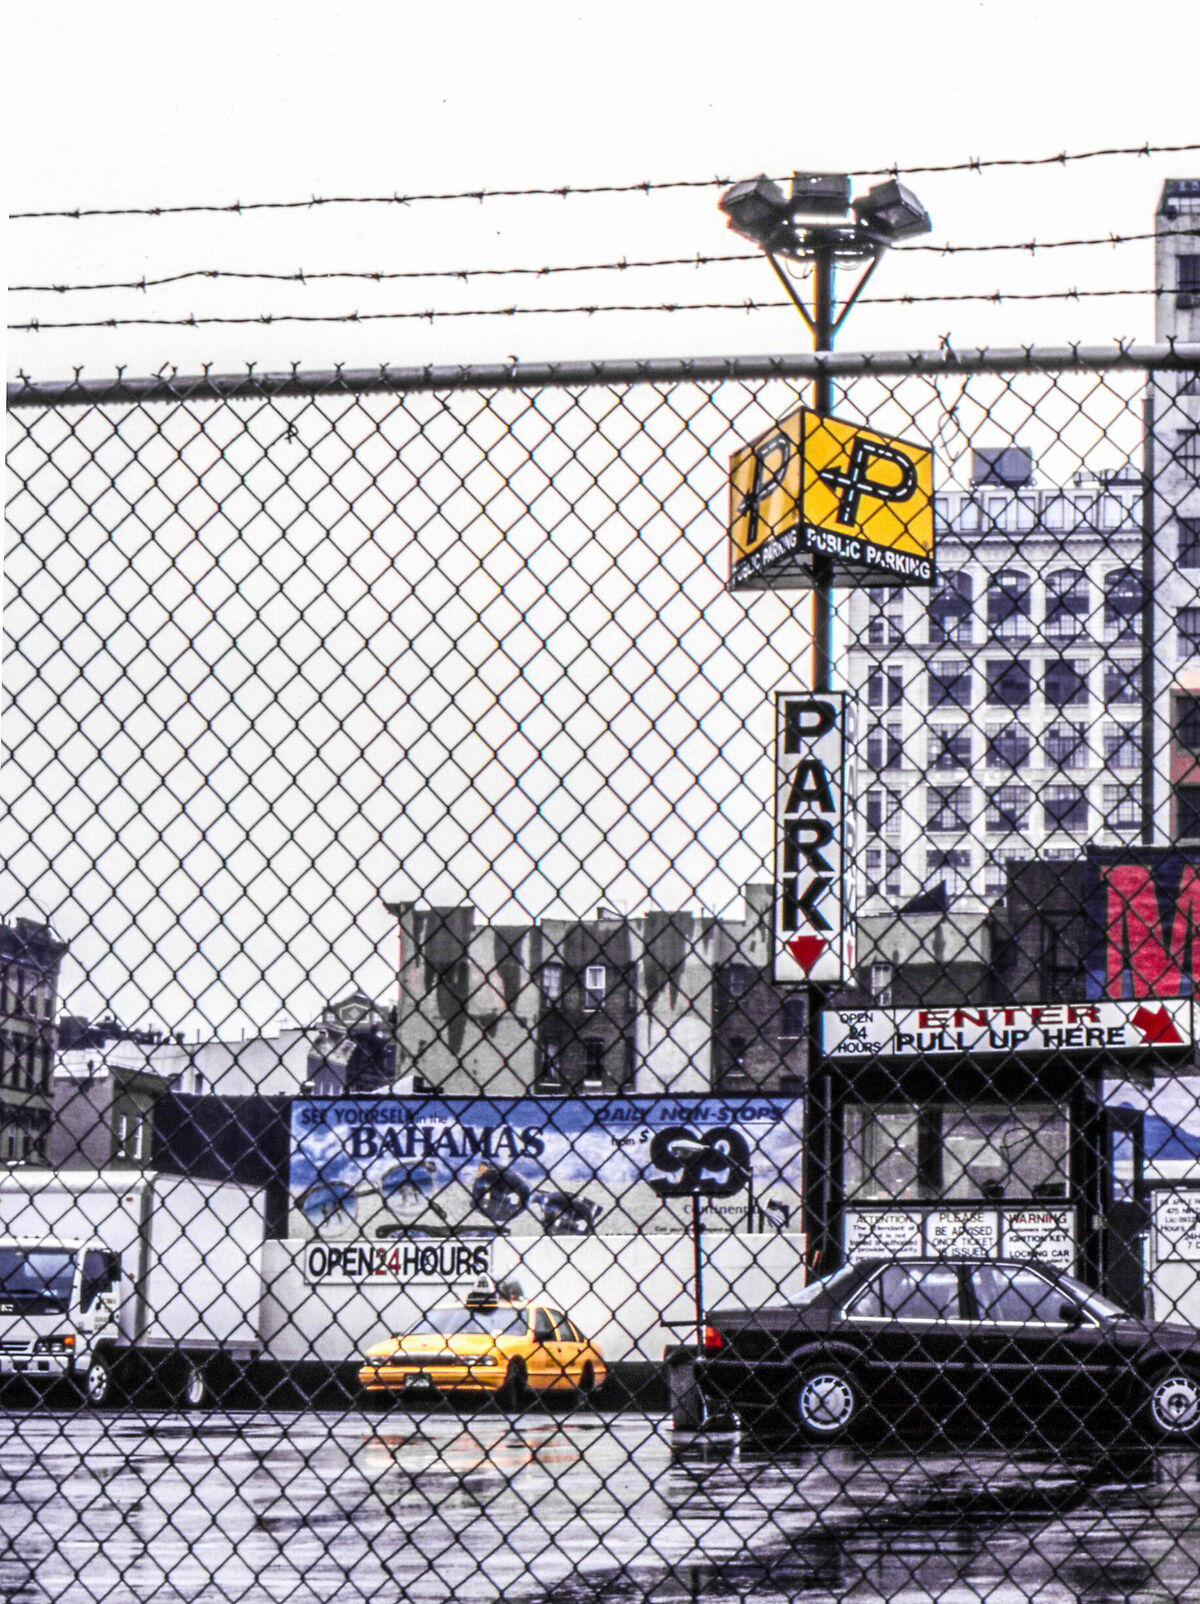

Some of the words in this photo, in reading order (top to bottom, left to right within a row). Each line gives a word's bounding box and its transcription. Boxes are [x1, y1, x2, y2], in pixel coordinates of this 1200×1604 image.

[806, 528, 861, 560] PUBLIC
[866, 545, 931, 579] PARKING
[782, 700, 837, 931] PARK
[839, 1012, 874, 1023] OPEN
[918, 1006, 1101, 1029] ENTER
[849, 1026, 867, 1040] 24
[896, 1031, 975, 1053] PULL
[989, 1029, 1030, 1050] UP
[1043, 1026, 1126, 1048] HERE
[837, 1041, 881, 1053] HOURS
[660, 1107, 783, 1122] NON-STOPS
[350, 1126, 546, 1160] BAHAMAS
[939, 1213, 984, 1223] PLEASE
[1009, 1214, 1067, 1224] WARNING
[935, 1227, 947, 1236] BE
[952, 1226, 993, 1236] ADISED
[962, 1237, 993, 1246] TICET
[1010, 1250, 1048, 1258] LOCNG
[308, 1247, 374, 1277] OPEN
[375, 1248, 401, 1276] 24
[403, 1246, 489, 1276] HOURS
